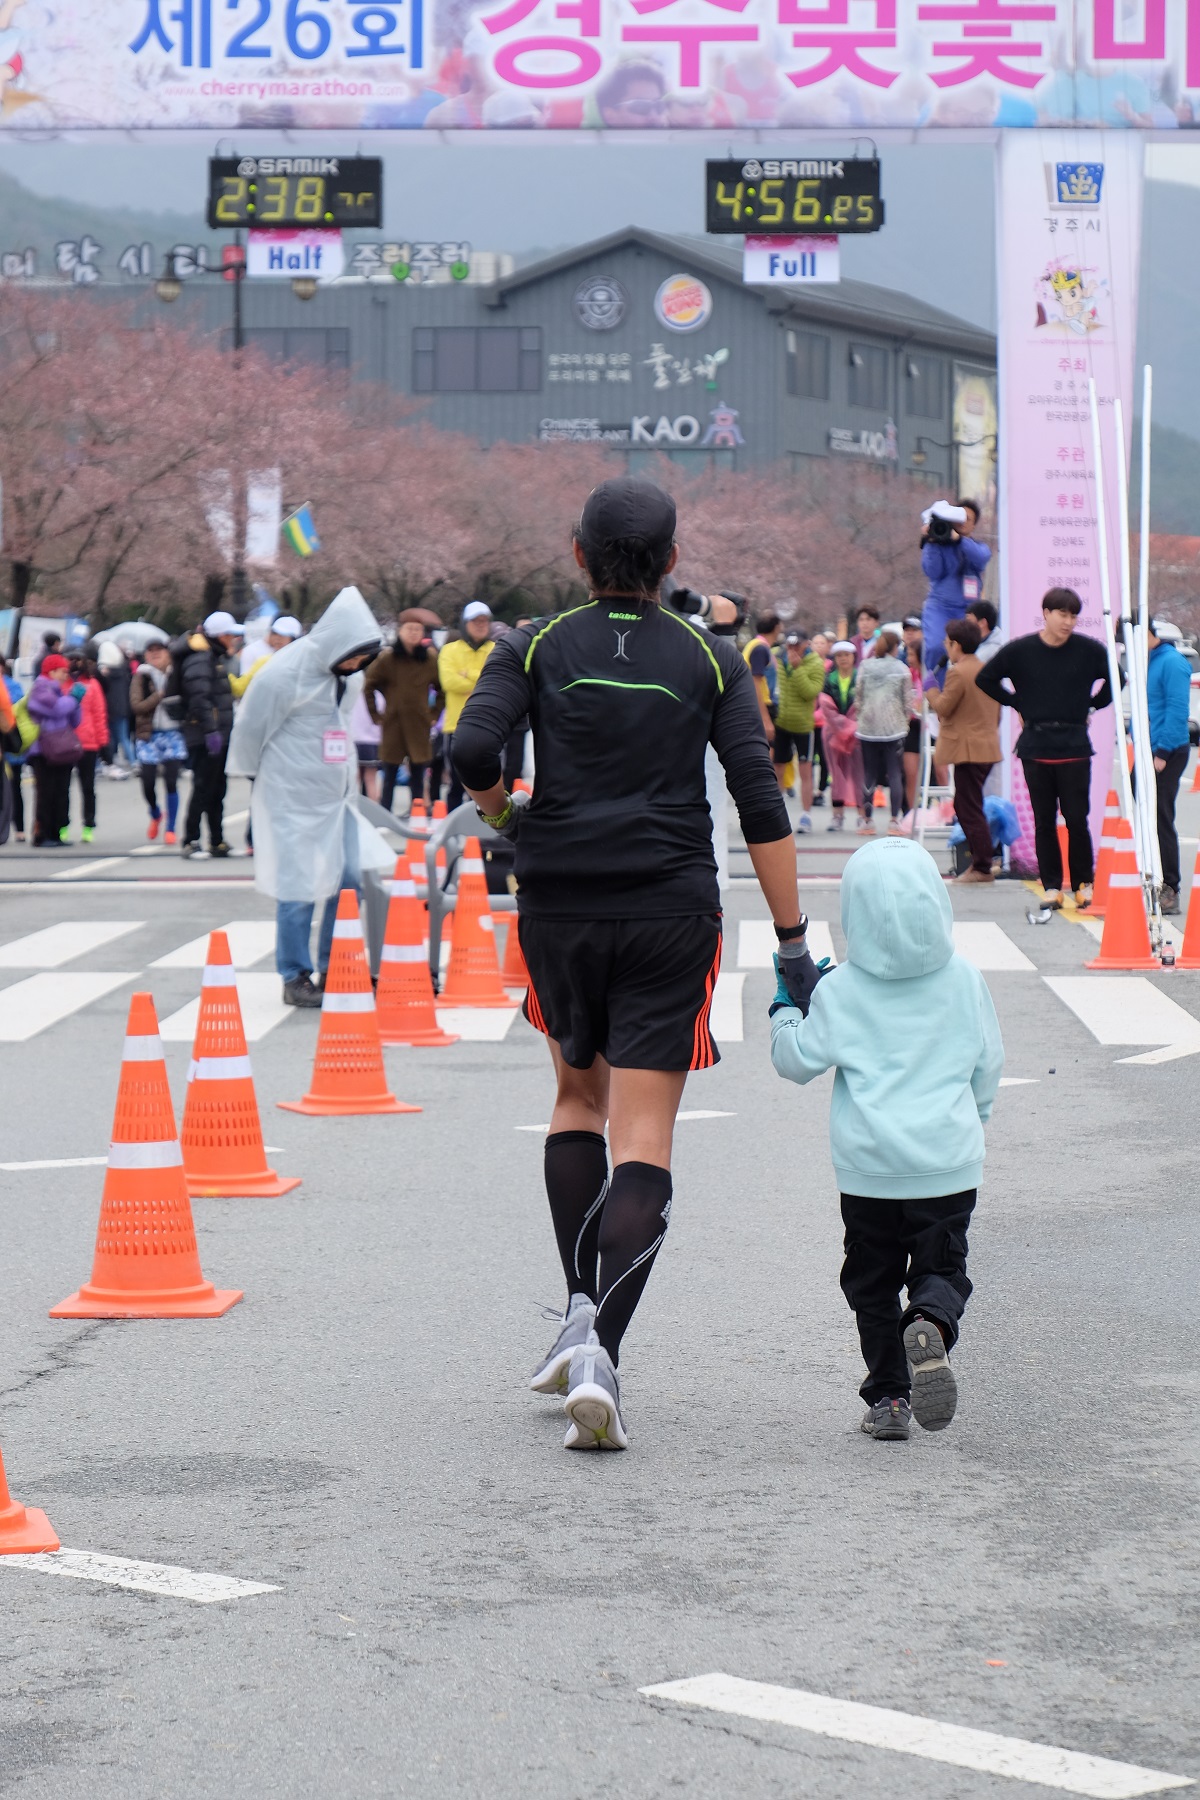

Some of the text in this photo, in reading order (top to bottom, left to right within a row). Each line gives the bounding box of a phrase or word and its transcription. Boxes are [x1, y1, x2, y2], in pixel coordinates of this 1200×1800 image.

[128, 0, 423, 69] 제26회
[164, 78, 404, 99] www.cherrymarathon.com
[257, 158, 340, 176] SAMIK
[762, 160, 845, 179] SAMIK
[268, 244, 323, 270] Half
[351, 241, 470, 281] 주렁주렁
[769, 251, 817, 277] Full
[1058, 357, 1087, 372] 주최
[1046, 411, 1092, 422] 한국관광공
[631, 414, 701, 445] KAO
[1056, 446, 1085, 462] 주관
[1056, 494, 1084, 509] 후원
